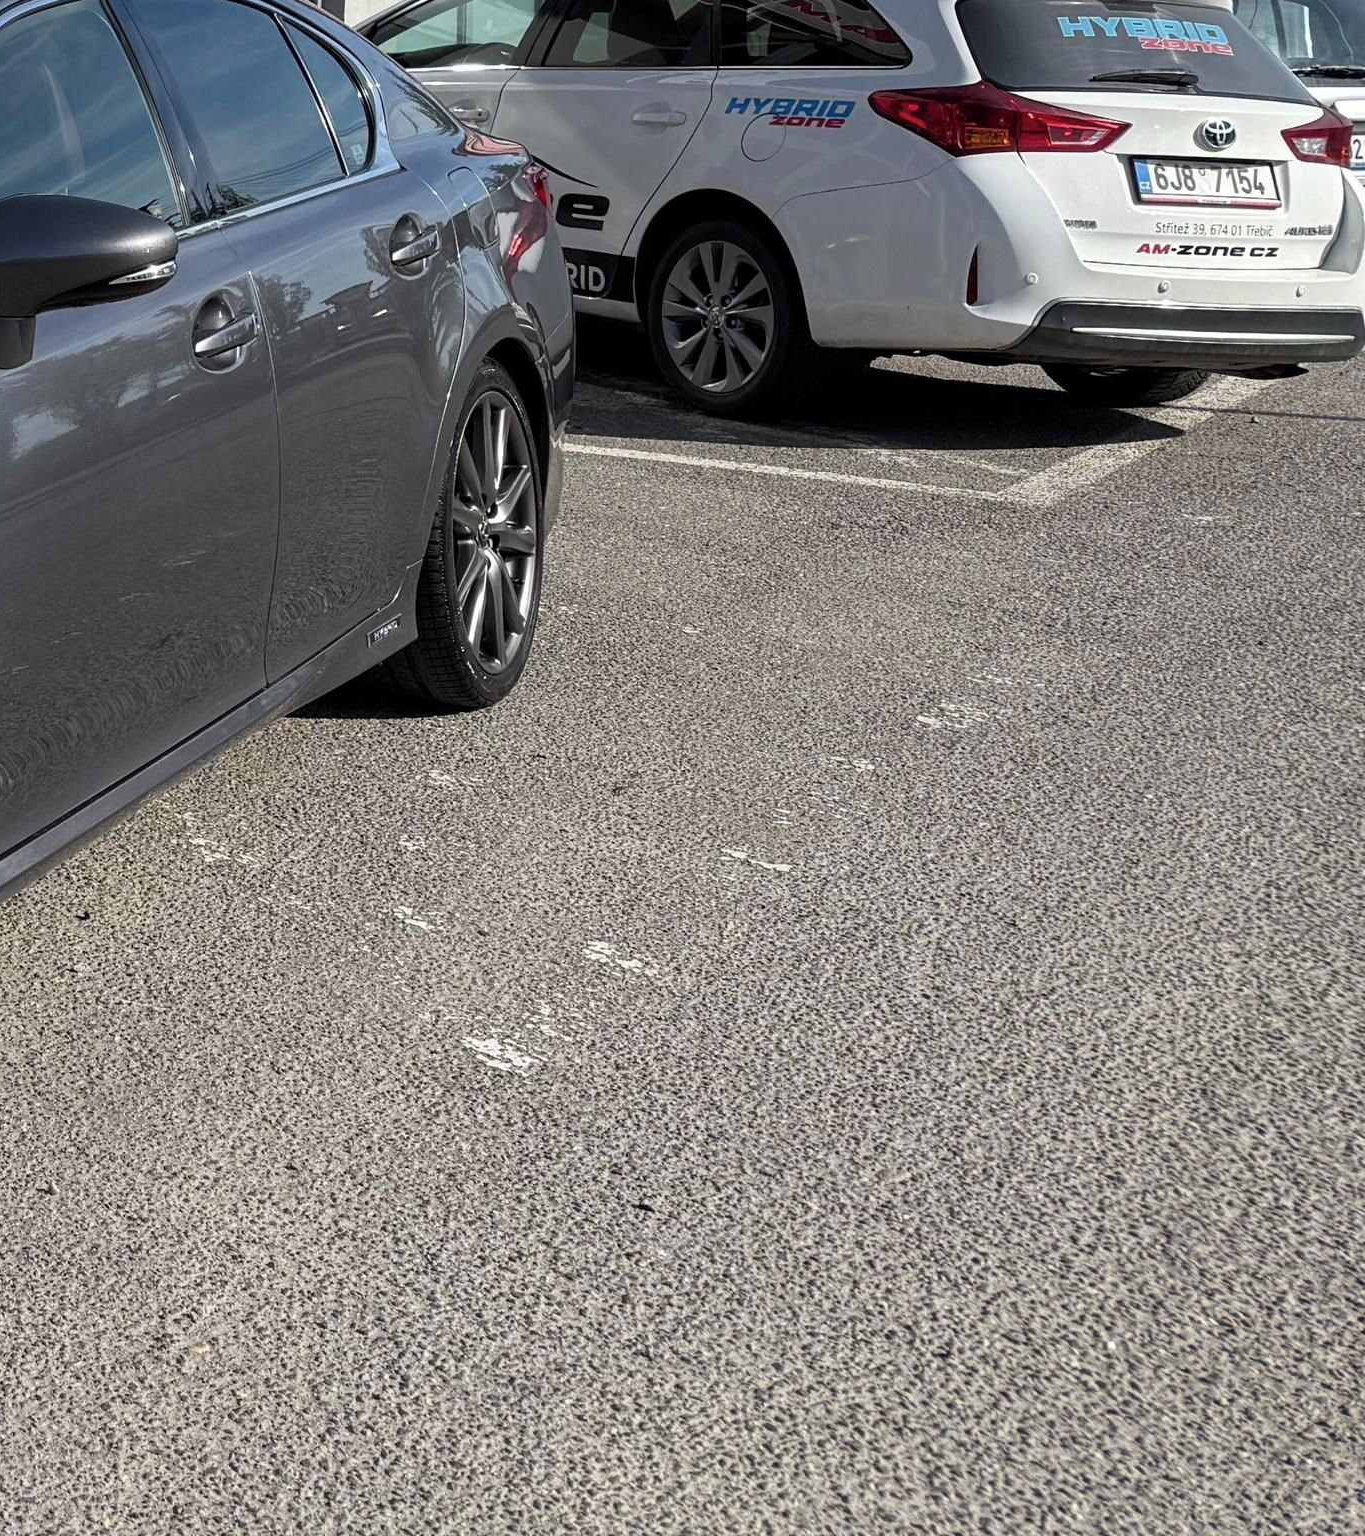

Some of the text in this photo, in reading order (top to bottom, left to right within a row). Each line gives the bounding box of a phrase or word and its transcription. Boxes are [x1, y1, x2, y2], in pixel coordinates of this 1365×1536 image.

[1057, 16, 1228, 44] HYBRID
[1139, 37, 1234, 56] zone
[725, 97, 857, 117] HYBRID
[769, 116, 846, 128] zone
[1155, 163, 1197, 192] 6J8
[1214, 165, 1266, 196] 7154
[1193, 223, 1207, 237] 39,
[1210, 224, 1229, 237] 674
[1231, 225, 1242, 237] 01
